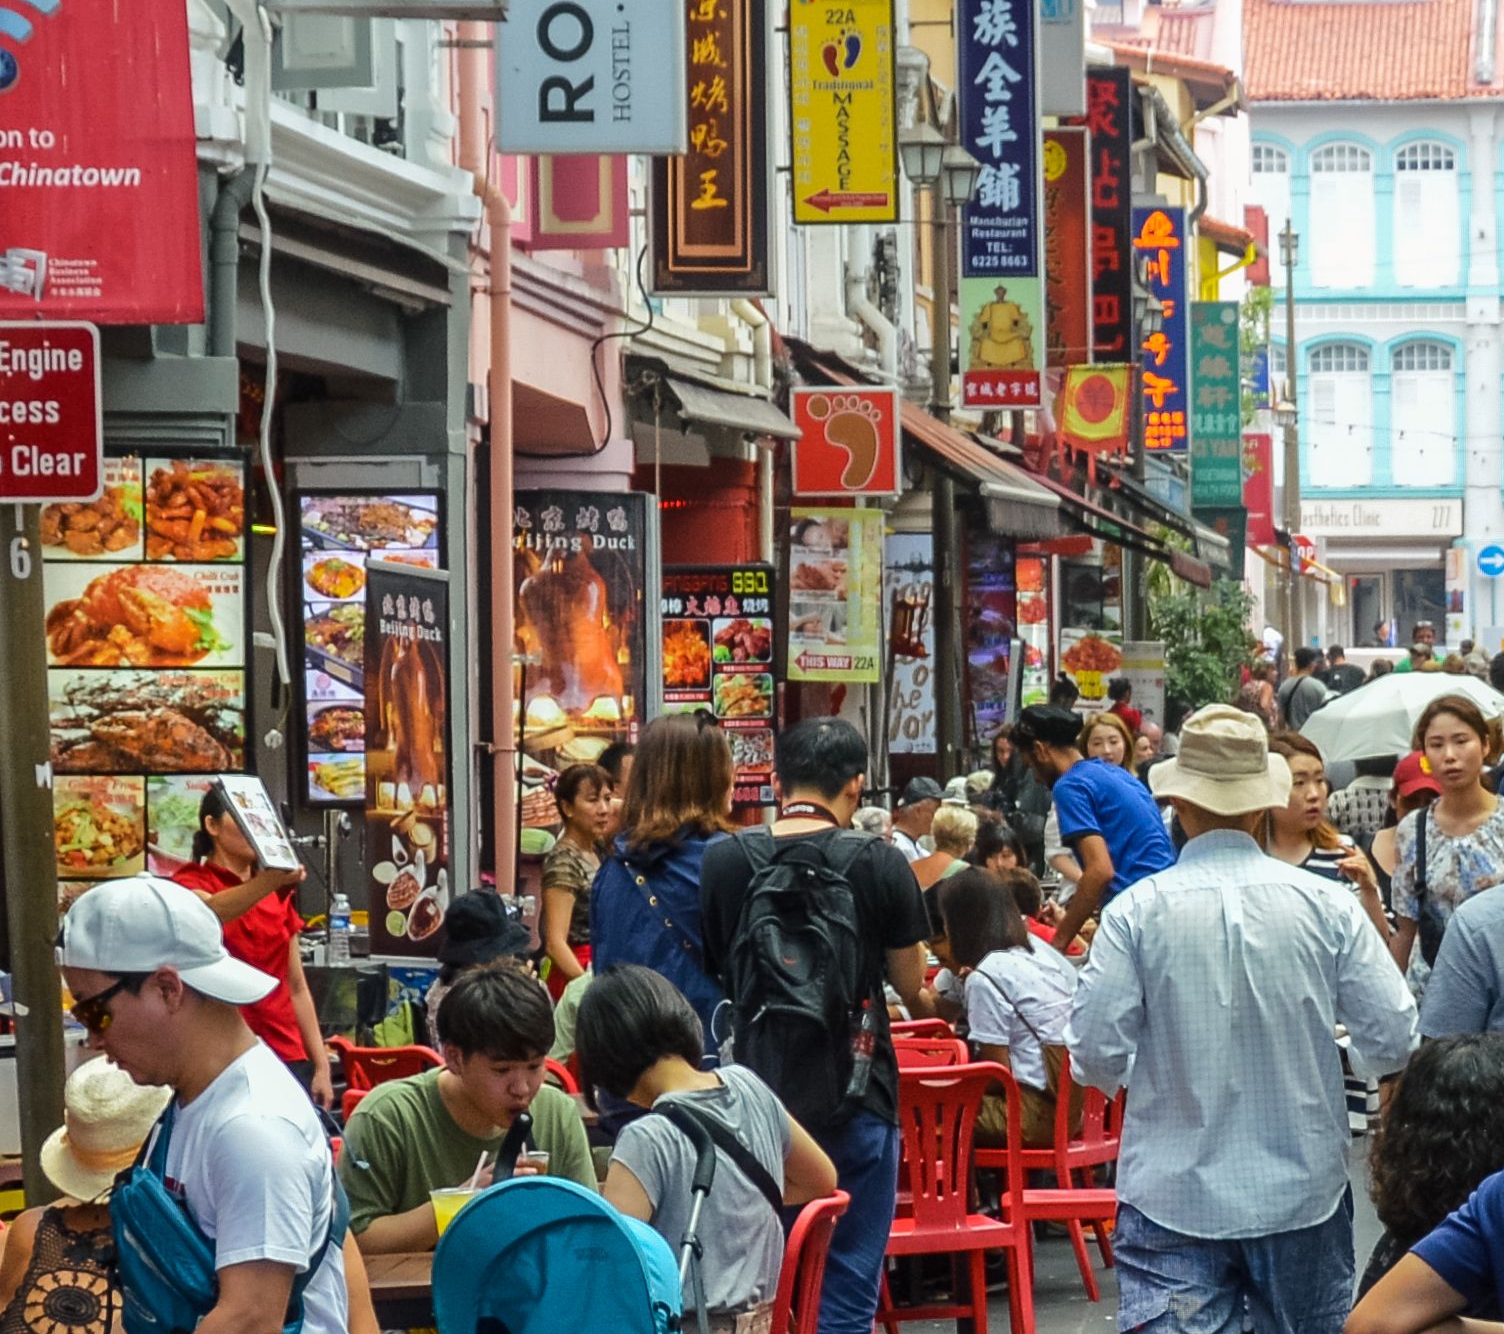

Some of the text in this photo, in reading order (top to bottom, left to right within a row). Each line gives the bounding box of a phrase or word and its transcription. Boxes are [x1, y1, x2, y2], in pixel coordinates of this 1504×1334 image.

[826, 9, 856, 24] 22A
[610, 23, 630, 124] HOSTEL
[812, 79, 874, 91] Traditional
[29, 126, 56, 149] to
[832, 92, 852, 191] MASSAGE
[970, 216, 1028, 228] Manchurian
[971, 227, 1027, 239] Restaurant
[986, 242, 1013, 254] TEL:
[971, 255, 999, 267] 6225
[11, 444, 86, 476] Clear
[1303, 505, 1348, 526] esthetics
[512, 534, 636, 552] eijing Duck
[1298, 546, 1314, 559] OP
[732, 570, 769, 593] BBQ
[380, 618, 443, 641] Beijing Duck
[800, 656, 874, 670] THIS WAY 22A
